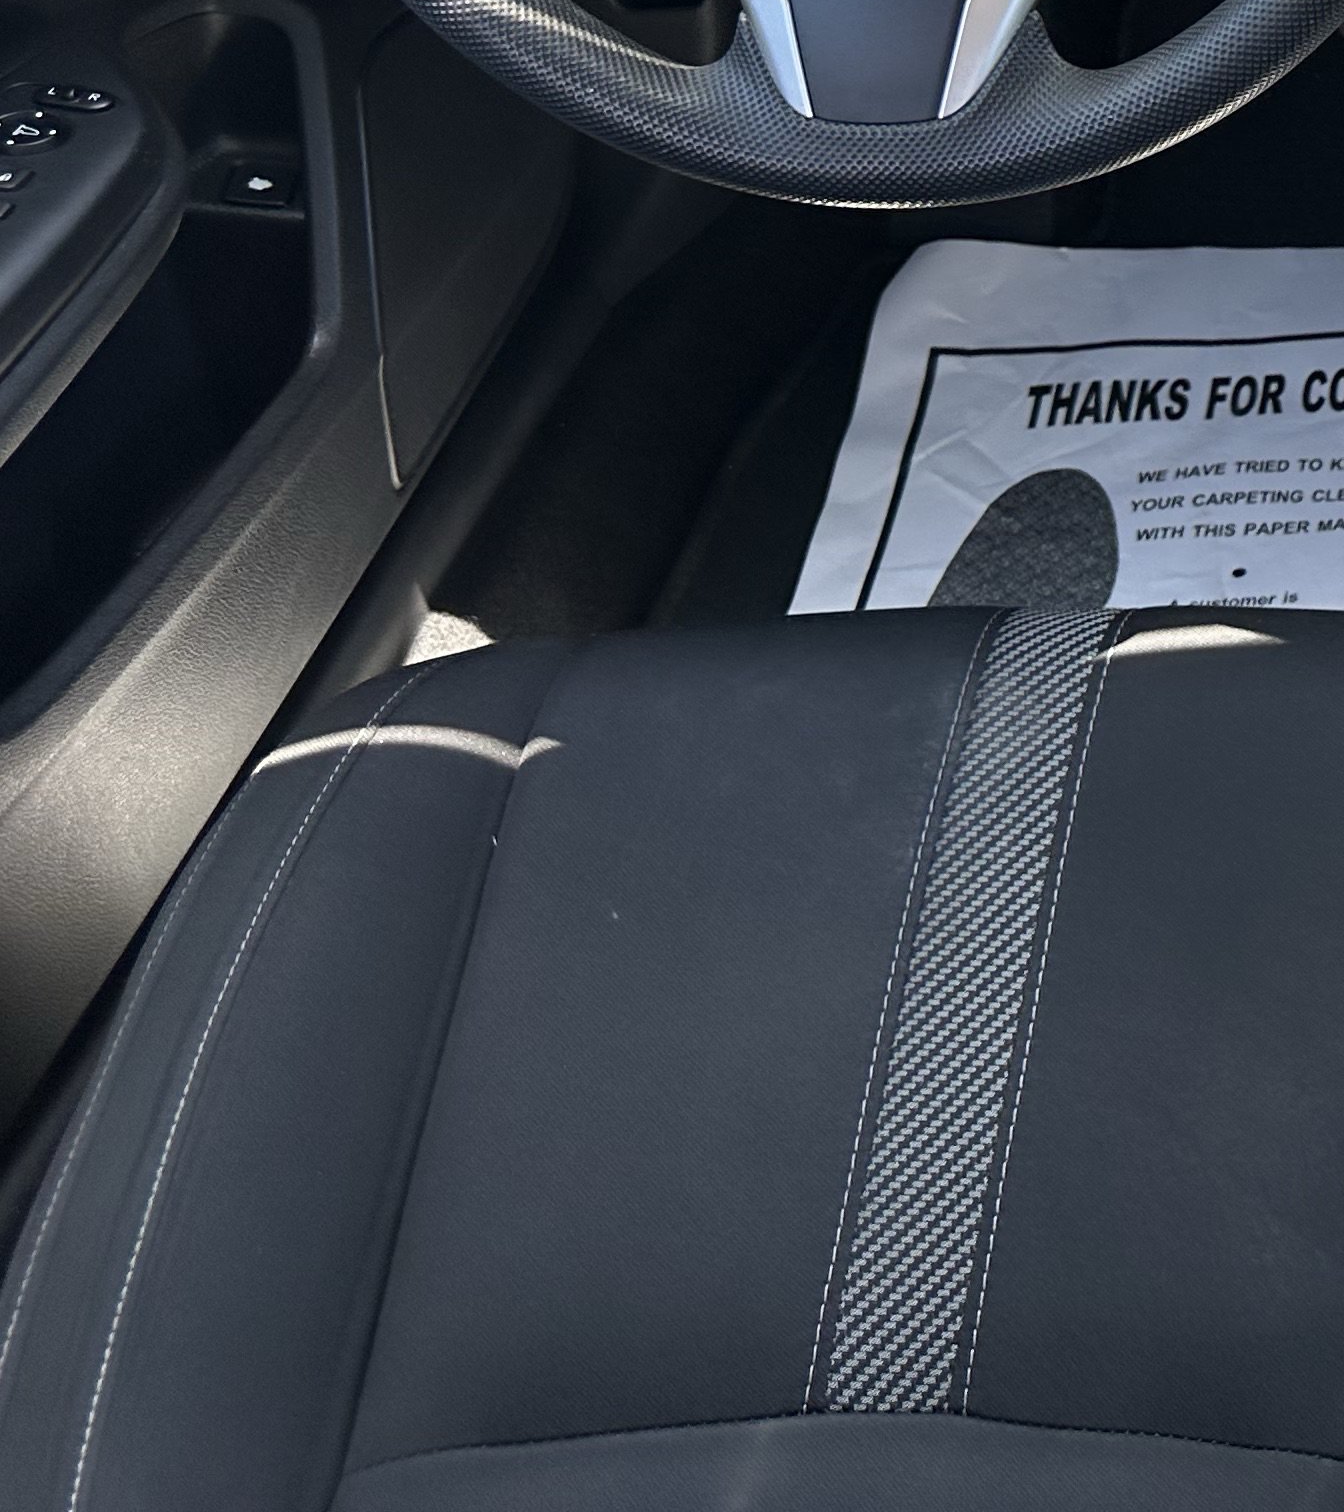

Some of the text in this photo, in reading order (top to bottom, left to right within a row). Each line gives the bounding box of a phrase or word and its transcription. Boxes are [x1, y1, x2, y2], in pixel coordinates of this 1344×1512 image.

[1026, 378, 1192, 429] THANKS
[1204, 373, 1286, 420] FOR
[1137, 469, 1168, 484] WE
[1175, 462, 1226, 481] HAVE
[1235, 459, 1290, 474] TRIED
[1298, 458, 1323, 471] TO
[1131, 495, 1185, 512] YOUR
[1192, 490, 1303, 508] CARPETING
[1136, 525, 1185, 541] WITH
[1194, 523, 1236, 537] THIS
[1243, 520, 1310, 536] PAPER
[1282, 591, 1298, 603] is
